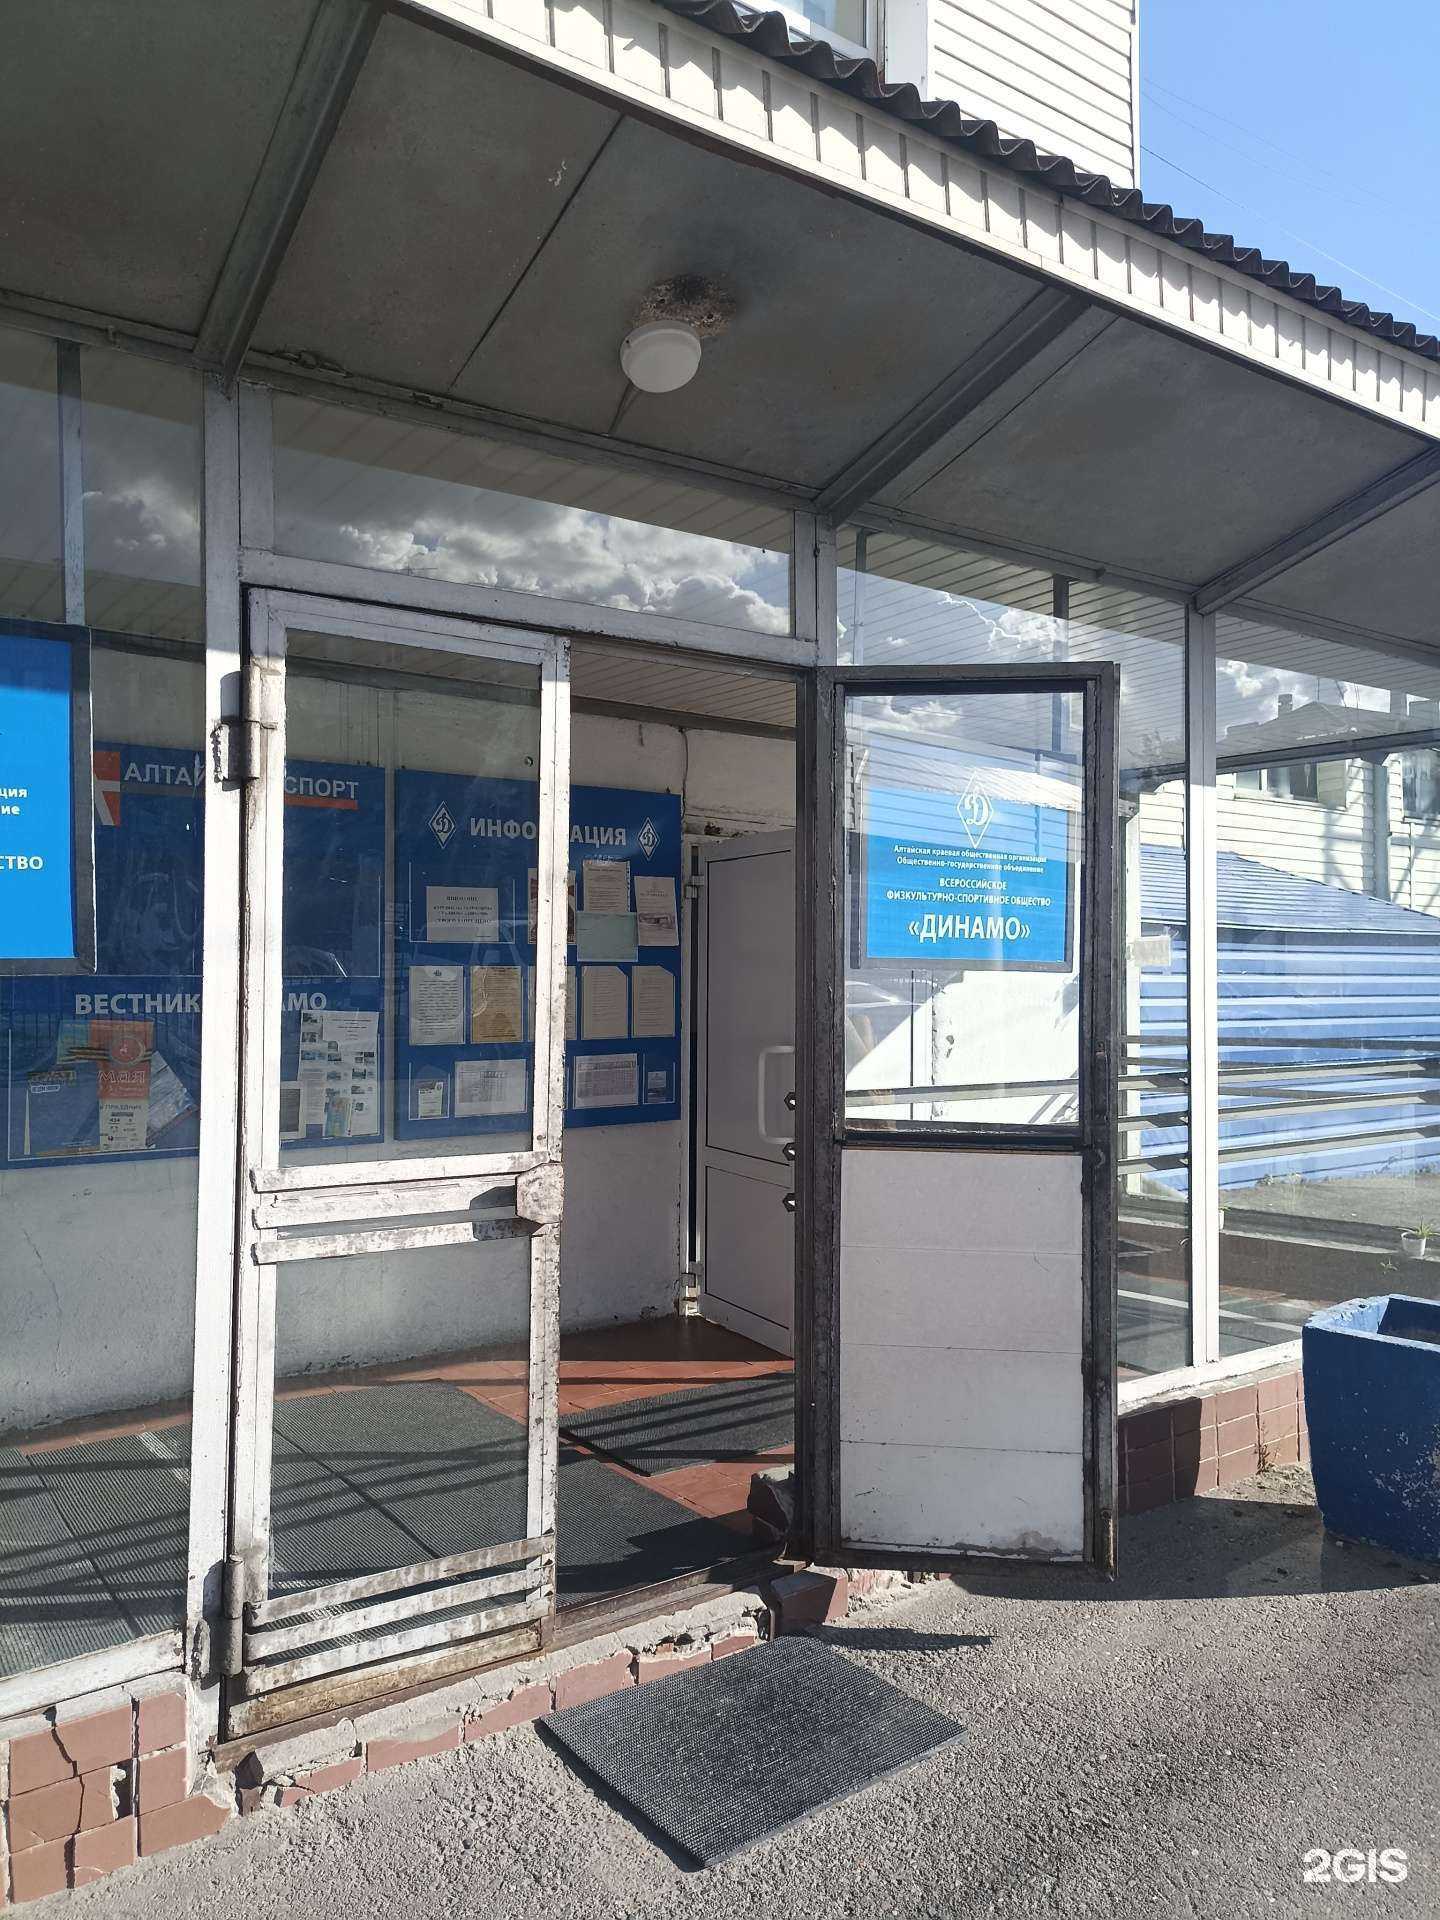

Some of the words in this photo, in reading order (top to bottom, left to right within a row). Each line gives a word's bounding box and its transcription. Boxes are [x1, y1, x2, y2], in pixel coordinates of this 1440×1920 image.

[284, 775, 359, 799] СПОРТ
[470, 817, 627, 848] ИНФОАЦИЯ
[939, 876, 1007, 891] ВСЕРОССИЙСКОЕ
[886, 889, 1010, 905] ФИЗКУЛЬТУРНО-СПОРТИВНОЕ
[1010, 896, 1051, 908] ОБЩЕСТВО
[908, 913, 1031, 944] «ДИНАМО»
[75, 992, 201, 1015] ВЕСТНИК
